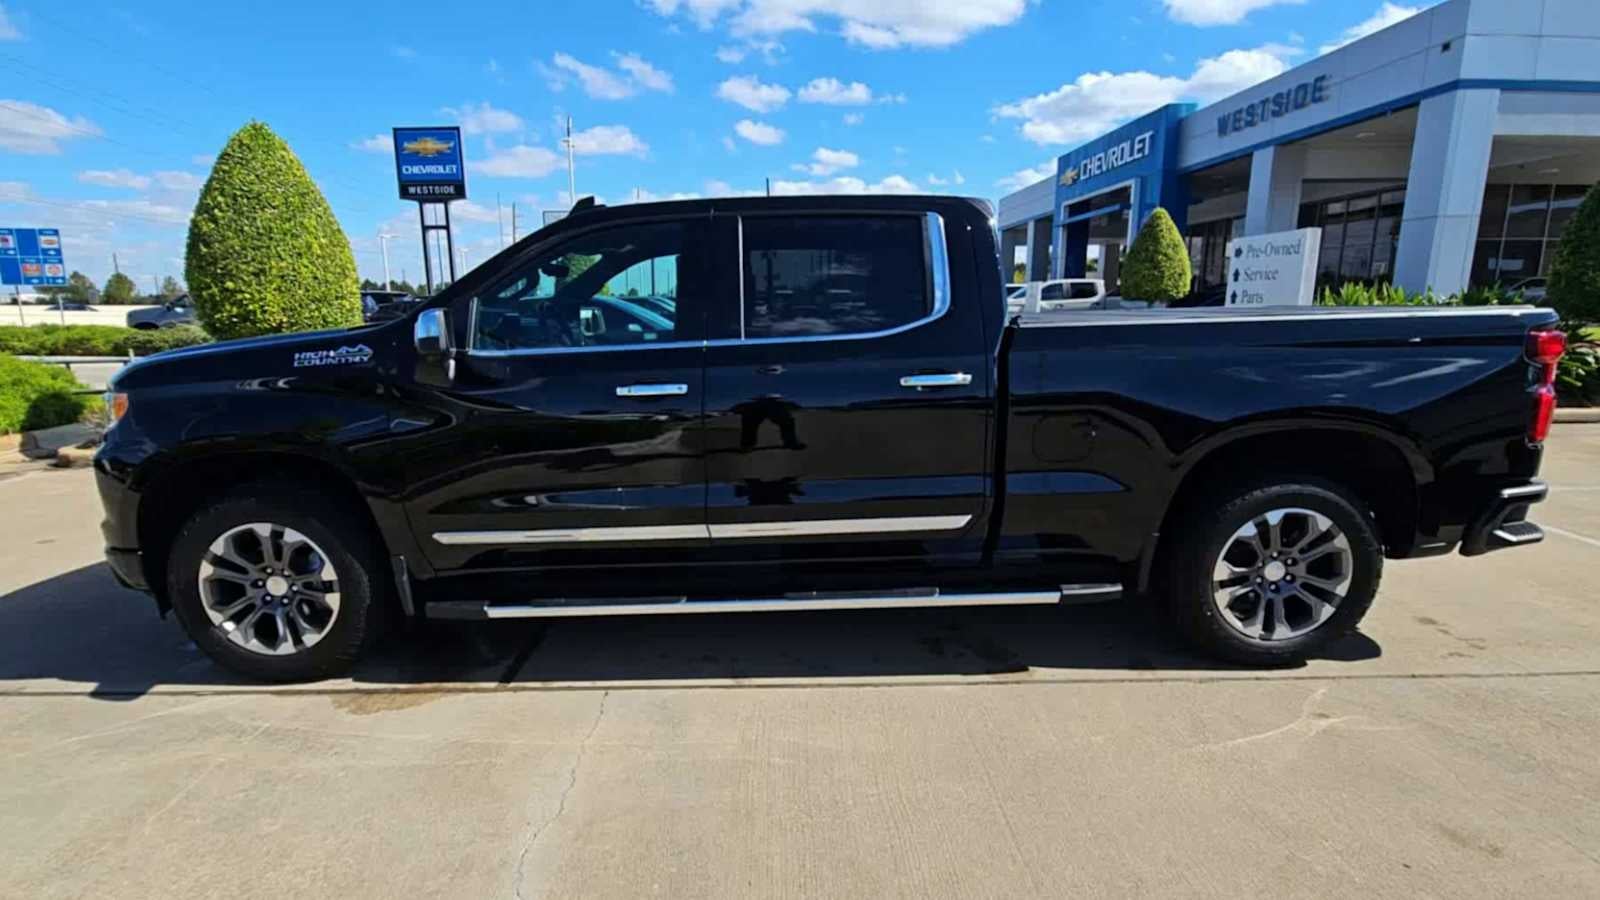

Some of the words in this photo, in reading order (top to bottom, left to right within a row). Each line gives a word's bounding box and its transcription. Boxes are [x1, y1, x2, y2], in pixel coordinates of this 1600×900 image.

[1217, 74, 1329, 138] WESTSIDE
[1080, 130, 1154, 180] CHEVROLET
[402, 164, 457, 175] CHEVROLET
[408, 185, 456, 194] WESTSIDE
[1246, 238, 1302, 259] Pre-Owned
[1244, 267, 1280, 281] Service
[1241, 289, 1264, 304] Parts
[294, 355, 370, 367] COUNTRY
